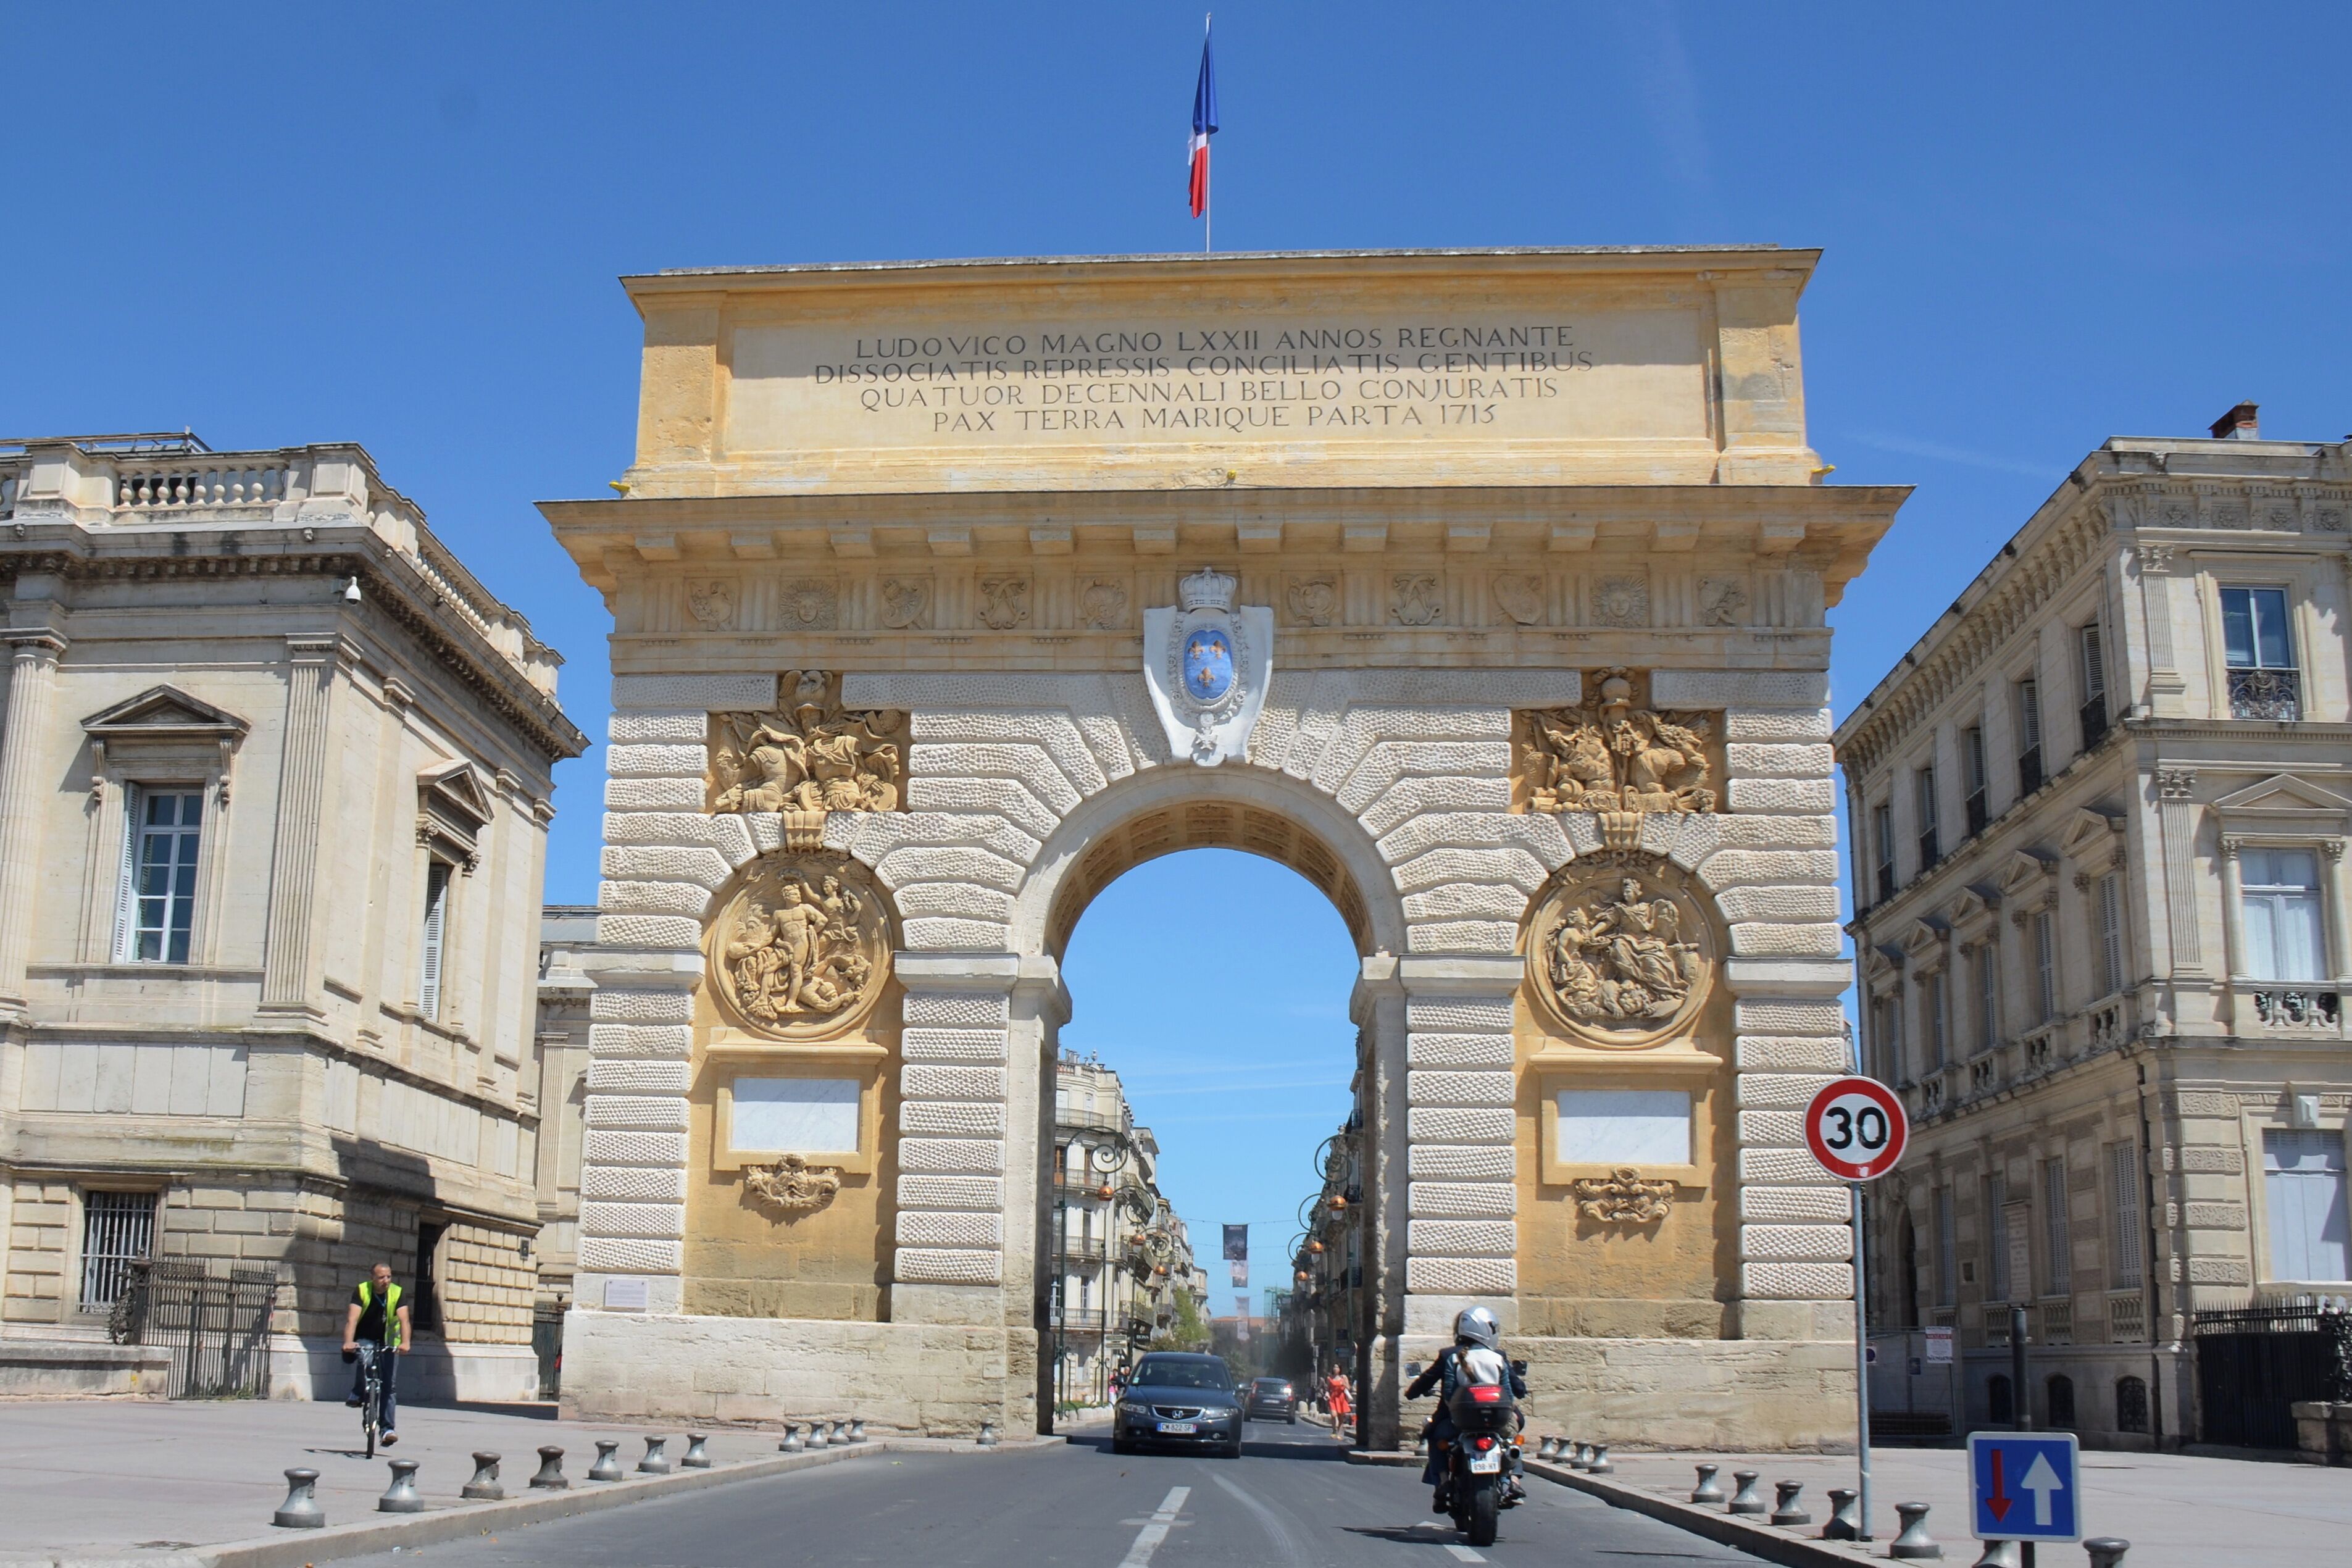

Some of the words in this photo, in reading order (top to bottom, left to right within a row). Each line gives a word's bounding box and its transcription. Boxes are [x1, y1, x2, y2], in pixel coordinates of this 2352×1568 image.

[856, 335, 1026, 359] LUDOVICO
[1042, 332, 1162, 354] MAGNO
[1178, 330, 1258, 351] LXXII
[1275, 328, 1382, 350] ANNOS
[1398, 326, 1574, 348] REGNANTE
[815, 360, 1007, 385] DISSOCIATIS
[1023, 357, 1170, 380] REPRESSIS
[1186, 353, 1399, 377] CONCILIATIS
[1417, 351, 1593, 374] GENTIBUS
[860, 385, 1024, 412] QUATUOR
[1041, 381, 1225, 404] DECENNALI
[1240, 380, 1341, 402] BELLO
[1358, 377, 1558, 402] CONJURATIS
[933, 411, 996, 432] PAX
[1014, 409, 1125, 430] TERRA
[1142, 406, 1290, 433] MARIQUE
[1307, 404, 1423, 427] PARTA
[1440, 404, 1498, 425] 1715
[1825, 1106, 1887, 1149] 30
